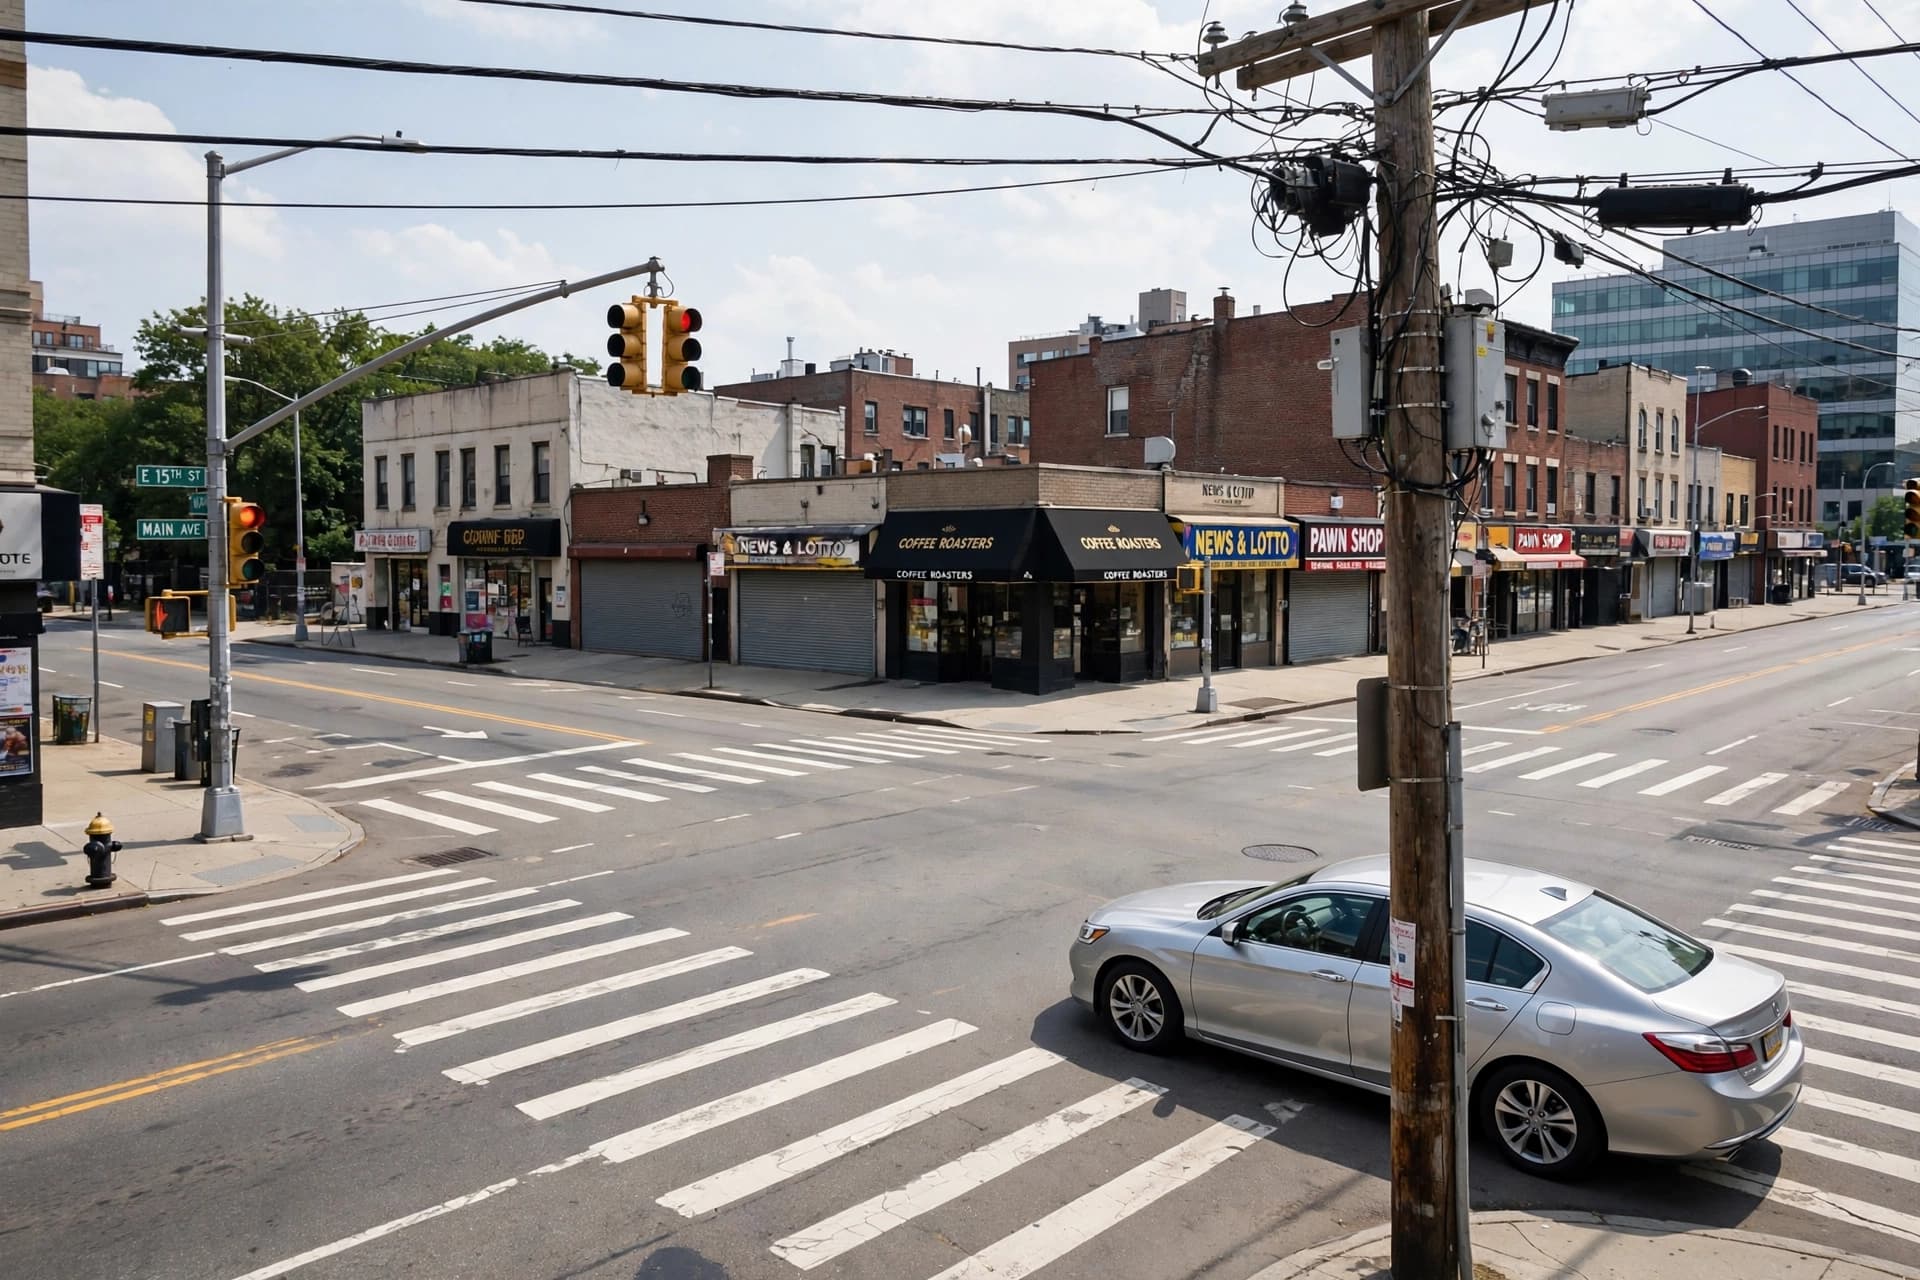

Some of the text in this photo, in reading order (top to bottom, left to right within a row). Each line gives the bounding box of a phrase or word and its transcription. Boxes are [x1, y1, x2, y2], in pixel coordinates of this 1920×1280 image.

[141, 468, 201, 484] E 15TH ST
[142, 522, 201, 537] MAIN AVE
[898, 536, 994, 550] COFFEE ROASTERS
[1080, 537, 1162, 550] COFFEE ROASTERS
[1195, 529, 1290, 556] NEWS & LOTTO
[1310, 527, 1384, 553] PAWN SHOP
[740, 541, 845, 556] NEWS & LOTTO
[930, 570, 973, 580] ROASTERS
[1103, 570, 1168, 580] COFFEE ROASTERS
